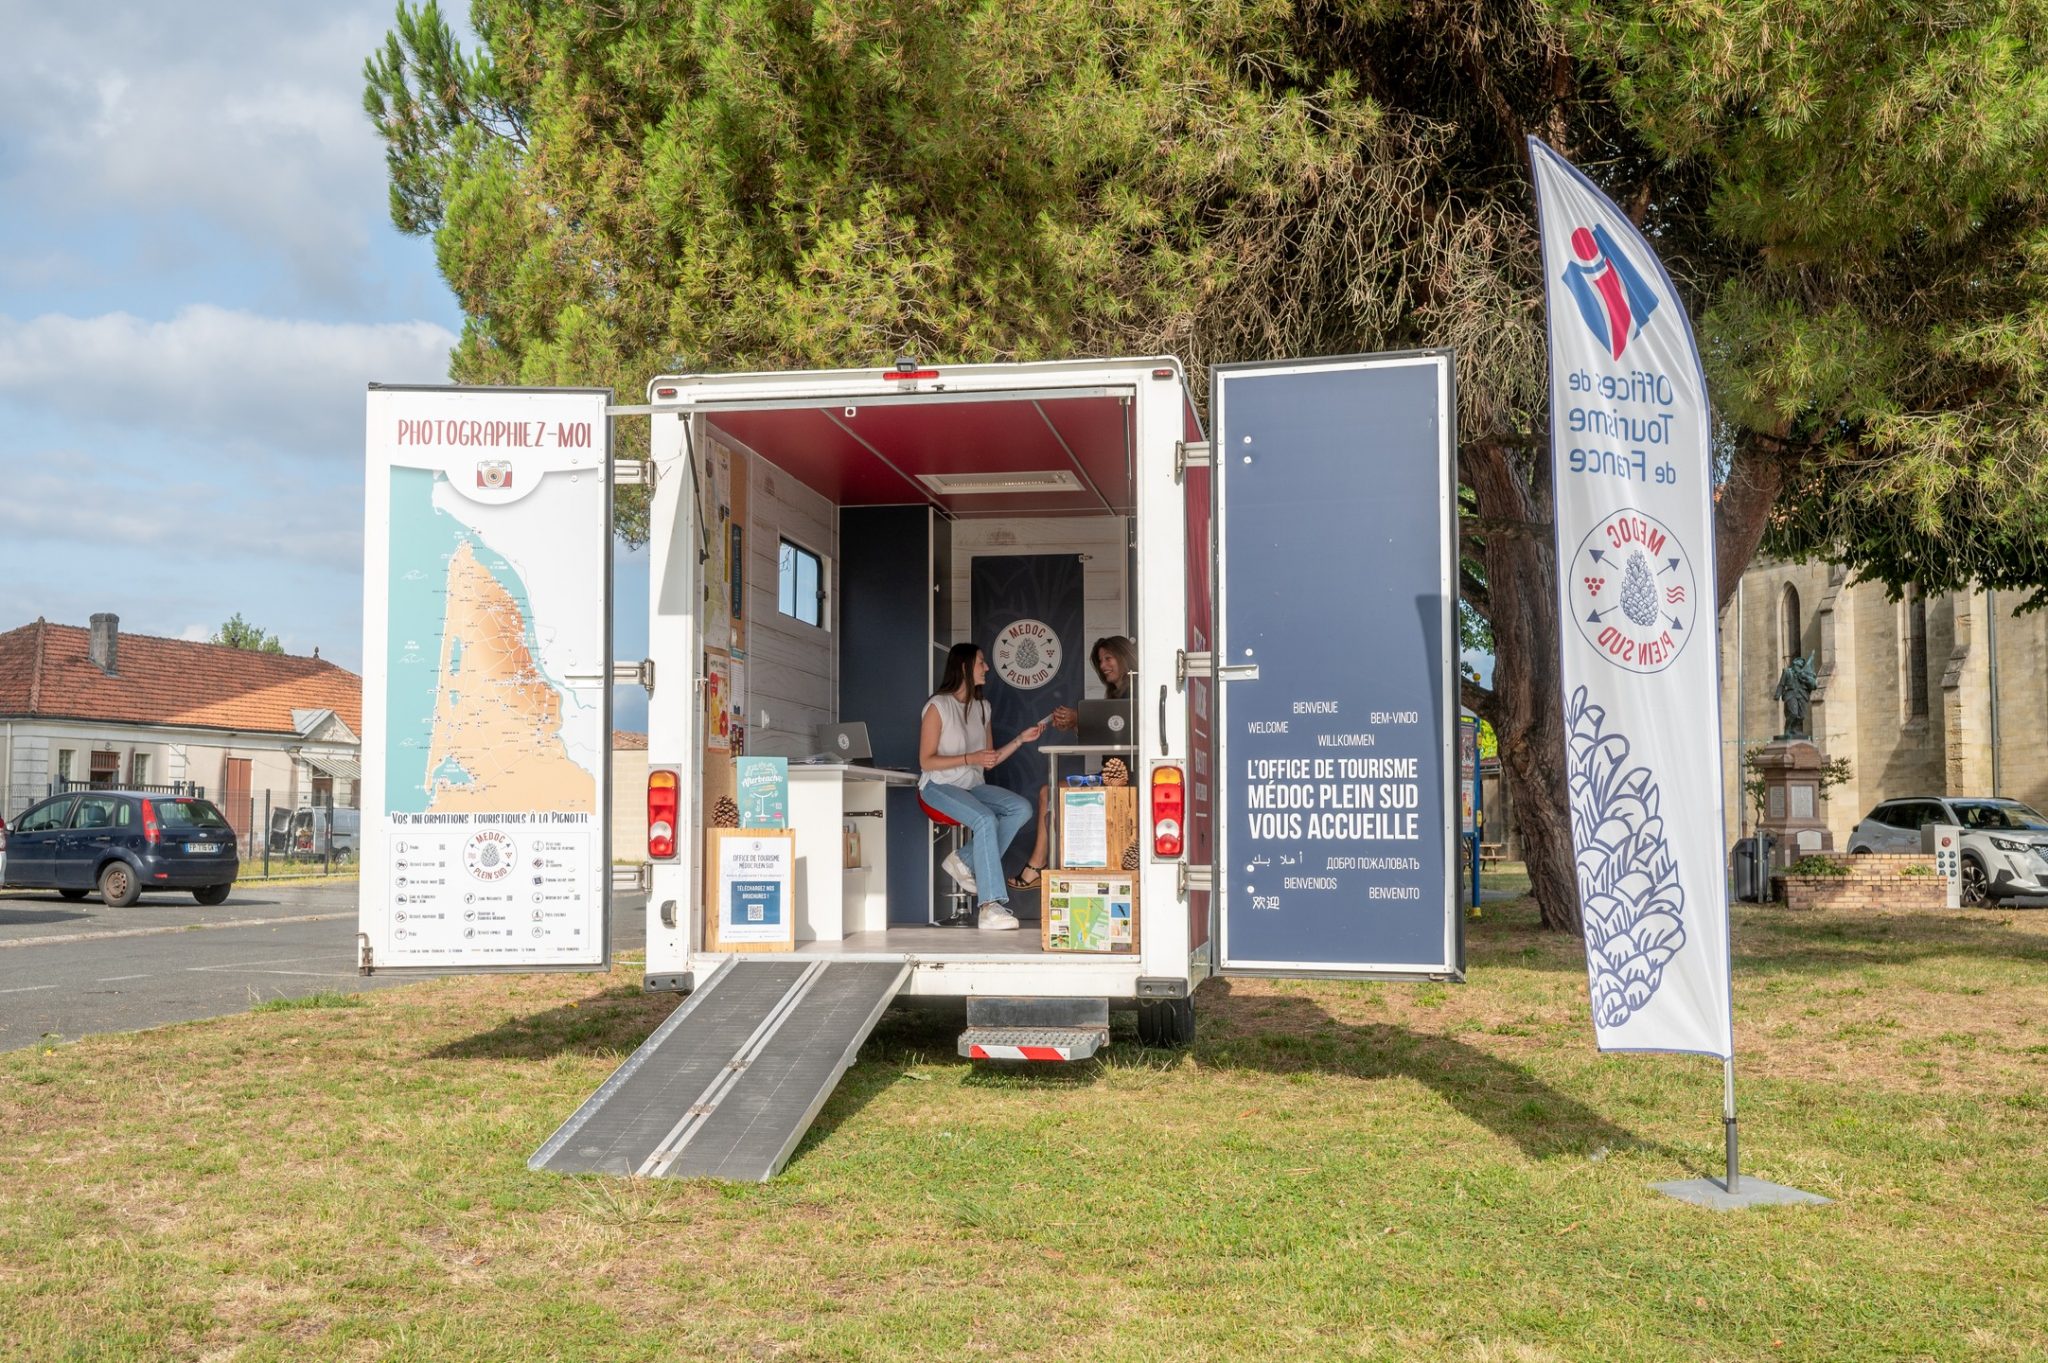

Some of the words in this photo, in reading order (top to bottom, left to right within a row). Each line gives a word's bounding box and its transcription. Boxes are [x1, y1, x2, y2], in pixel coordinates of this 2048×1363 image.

[398, 420, 592, 448] PHOTOGRAPHIEZ-MOI
[1008, 623, 1046, 639] MEDOC
[1006, 669, 1031, 685] PLEIN
[1032, 669, 1049, 684] SUD
[1293, 701, 1338, 714] BIENVENUE
[1370, 711, 1418, 724] BEM-VINDO
[1248, 721, 1289, 734] WELCOME
[1317, 734, 1375, 746] WILLKOMMEN
[1314, 759, 1334, 779] DE
[1338, 758, 1418, 779] TOURISME
[1248, 780, 1315, 809] MÉDOC
[1319, 784, 1374, 809] PLEIN
[1379, 783, 1419, 809] SUD
[1248, 813, 1302, 840] VOUS
[1307, 813, 1419, 840] ACCUEILLE
[475, 831, 506, 844] MEDOC
[732, 854, 749, 862] OFFICE
[750, 854, 756, 862] DE
[757, 854, 780, 862] TOURISME
[1326, 857, 1356, 870] ДОБРО
[1357, 857, 1420, 870] ПОЖАЛОВАТЬ
[473, 867, 493, 880] PLEIN
[493, 867, 507, 879] SUD
[1284, 877, 1338, 890] BIENVENIDOS
[1369, 887, 1420, 900] BENVENUTO
[1252, 896, 1280, 910] 欢迎
